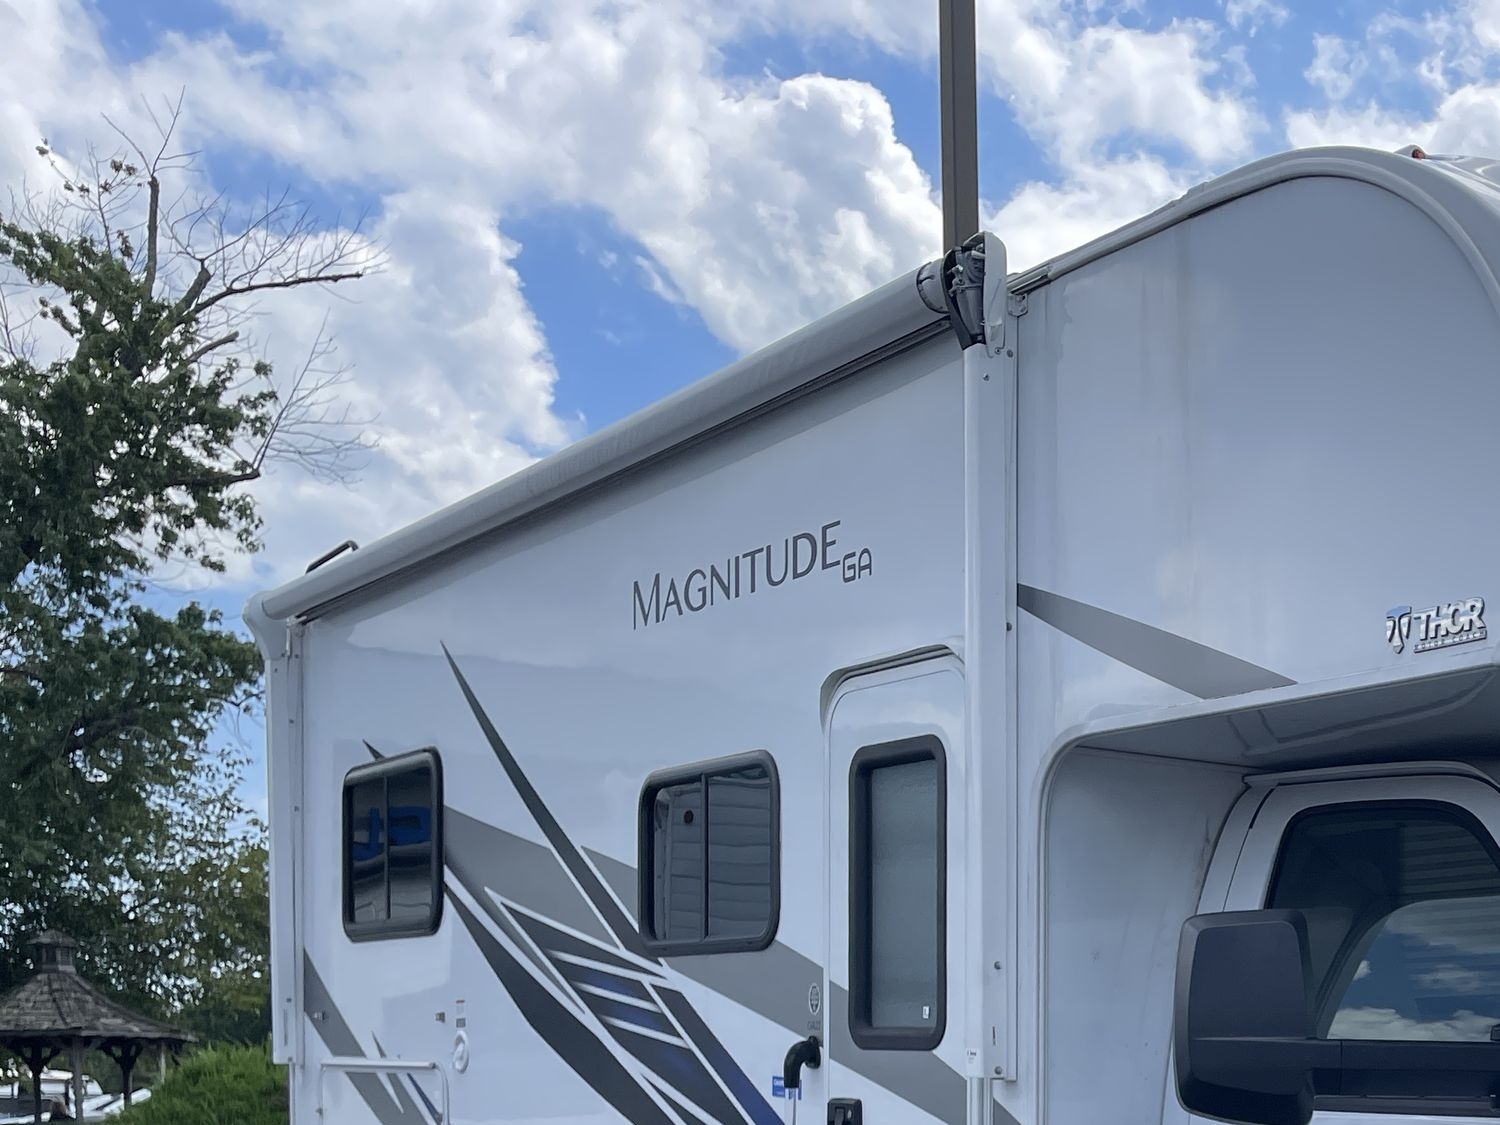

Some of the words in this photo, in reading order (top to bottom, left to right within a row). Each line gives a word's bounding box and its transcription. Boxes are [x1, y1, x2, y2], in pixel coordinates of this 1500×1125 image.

[633, 519, 841, 631] MAGNITUDE
[842, 547, 872, 583] GA
[1413, 597, 1486, 642] THOR
